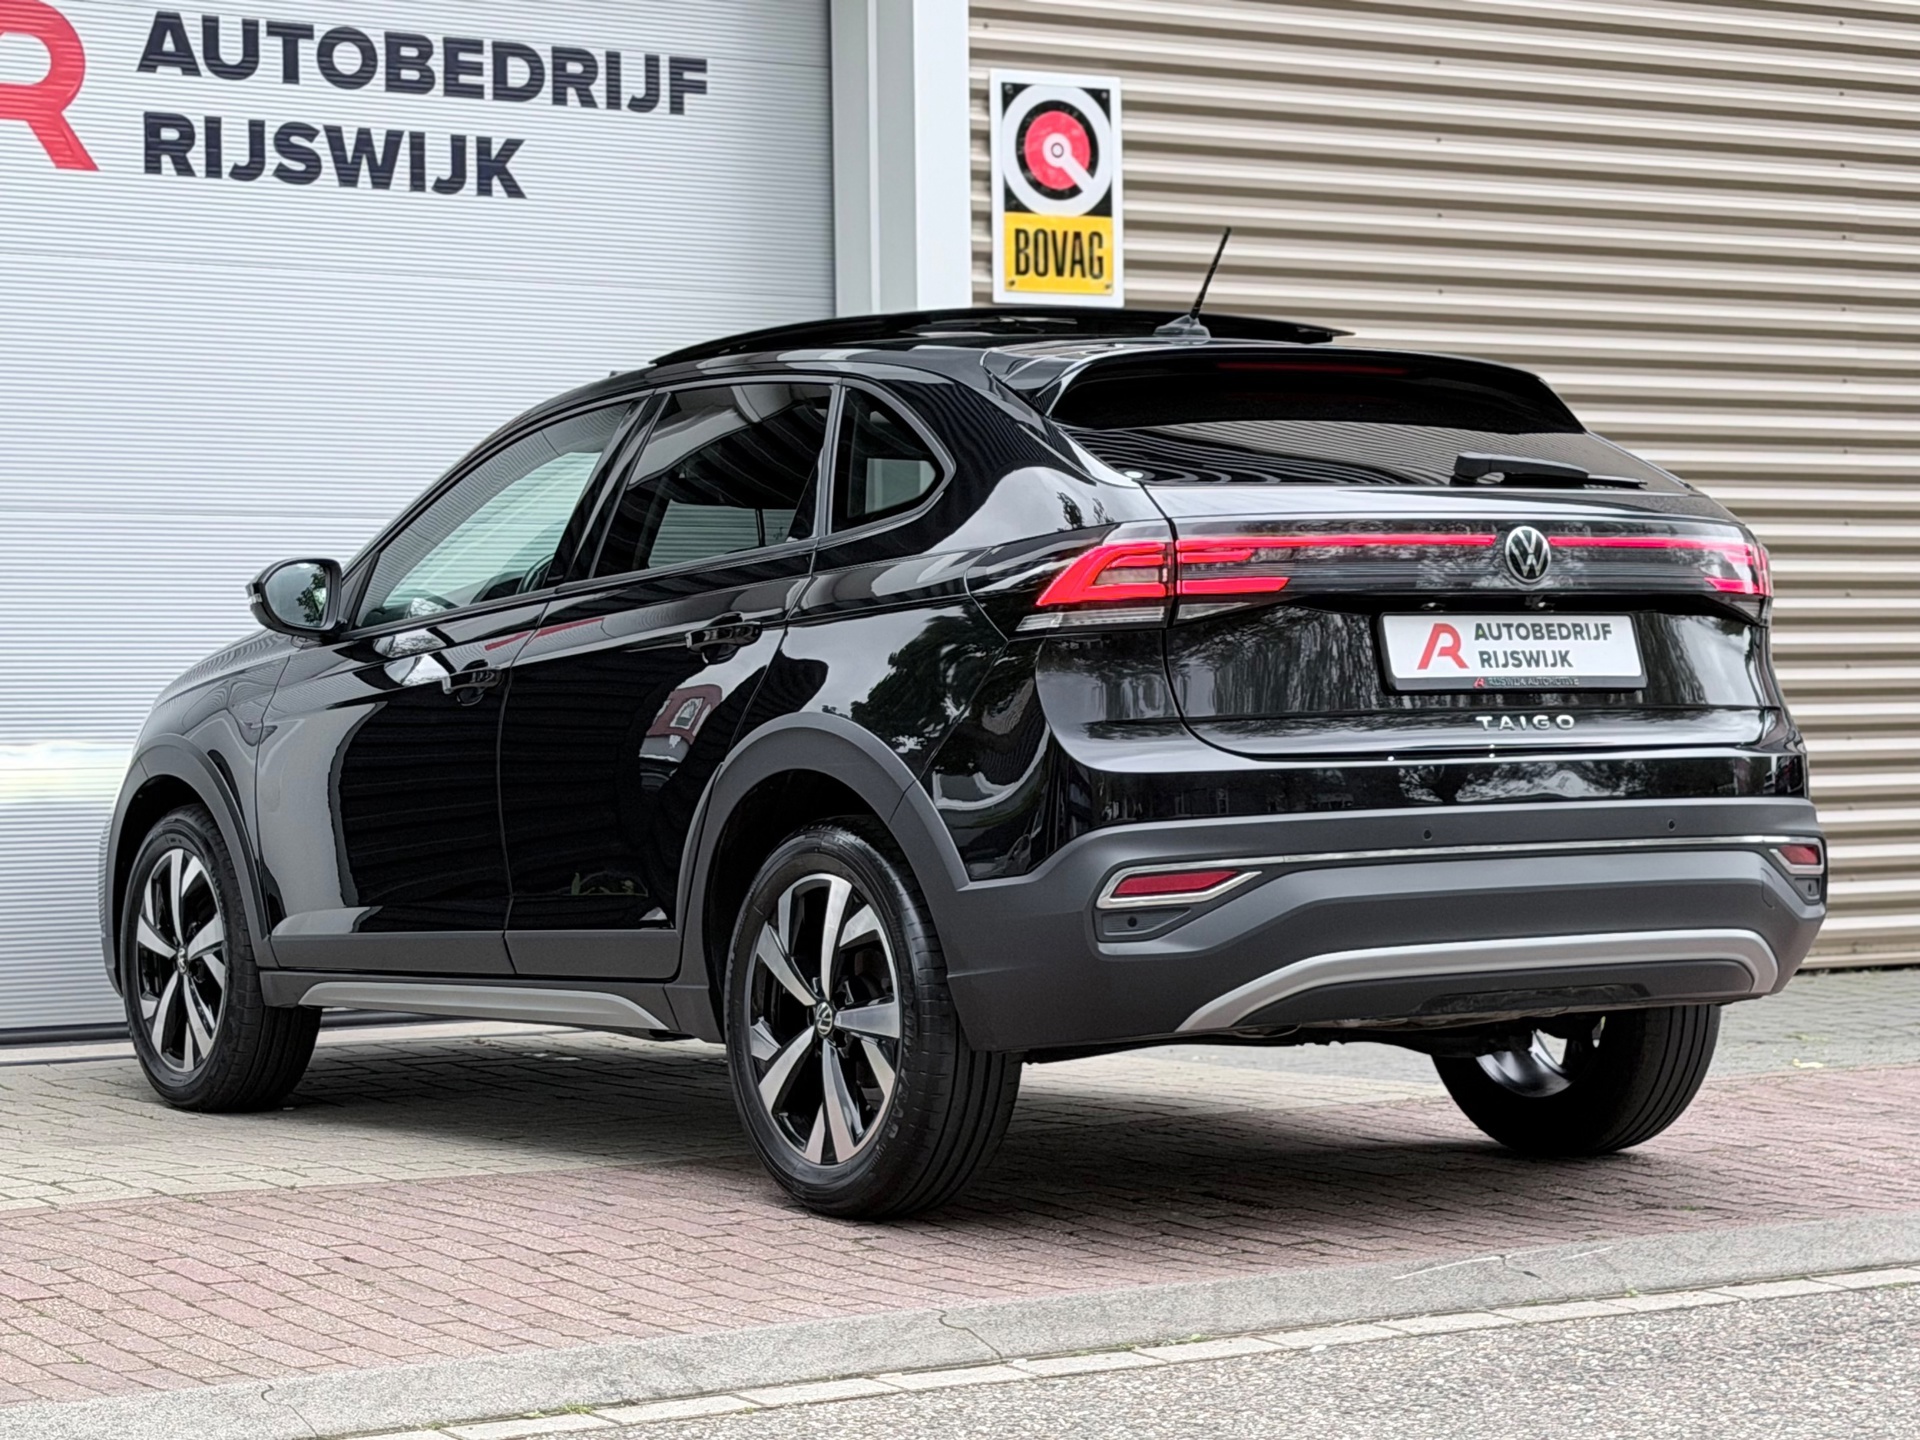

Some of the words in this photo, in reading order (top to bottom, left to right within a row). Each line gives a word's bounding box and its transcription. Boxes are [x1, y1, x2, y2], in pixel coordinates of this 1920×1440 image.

[137, 11, 708, 115] AUTOBEDRIJF
[143, 111, 527, 199] RIJSWIJK
[1014, 227, 1104, 280] BOVAG
[1474, 622, 1612, 642] AUTOBEDRIJF
[1478, 650, 1573, 669] RIJSWIJK
[1475, 714, 1576, 731] TAIGO
